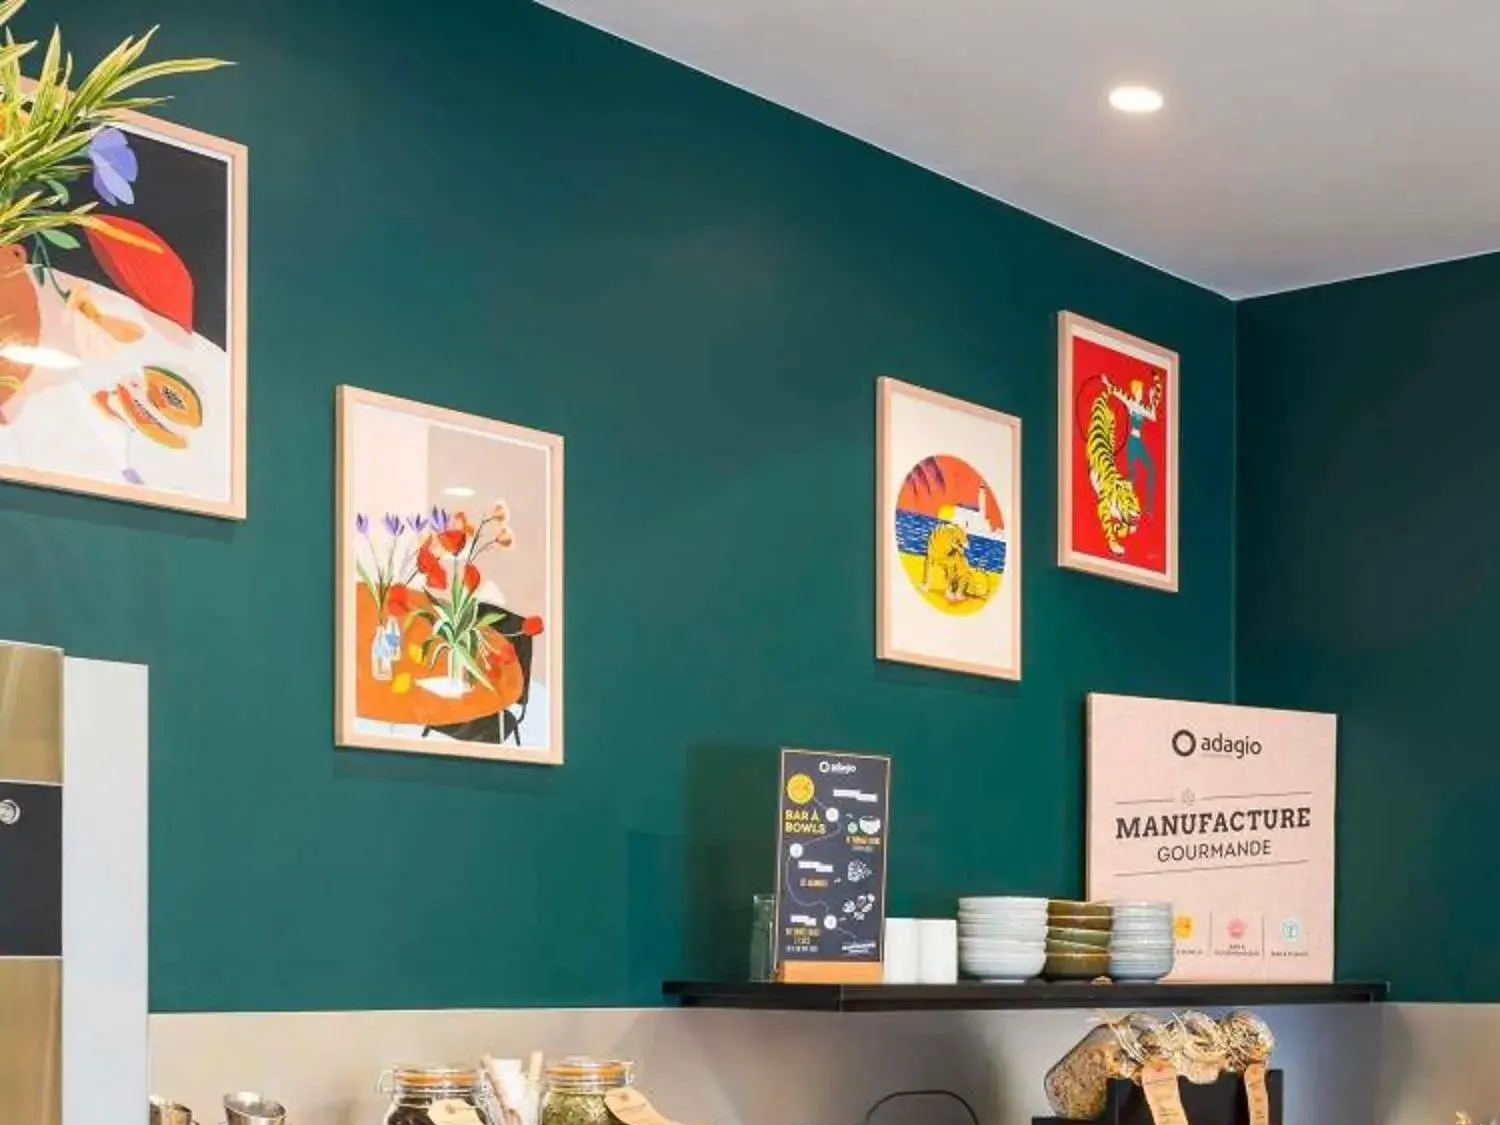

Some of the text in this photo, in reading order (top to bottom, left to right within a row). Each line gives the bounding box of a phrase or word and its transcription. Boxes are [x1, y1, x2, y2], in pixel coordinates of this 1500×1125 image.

[1201, 733, 1262, 759] adagio
[785, 809, 809, 822] BAR
[1115, 807, 1311, 840] MANUFACTURE
[785, 821, 827, 835] BOWLS
[1157, 839, 1272, 863] GOURMANDE
